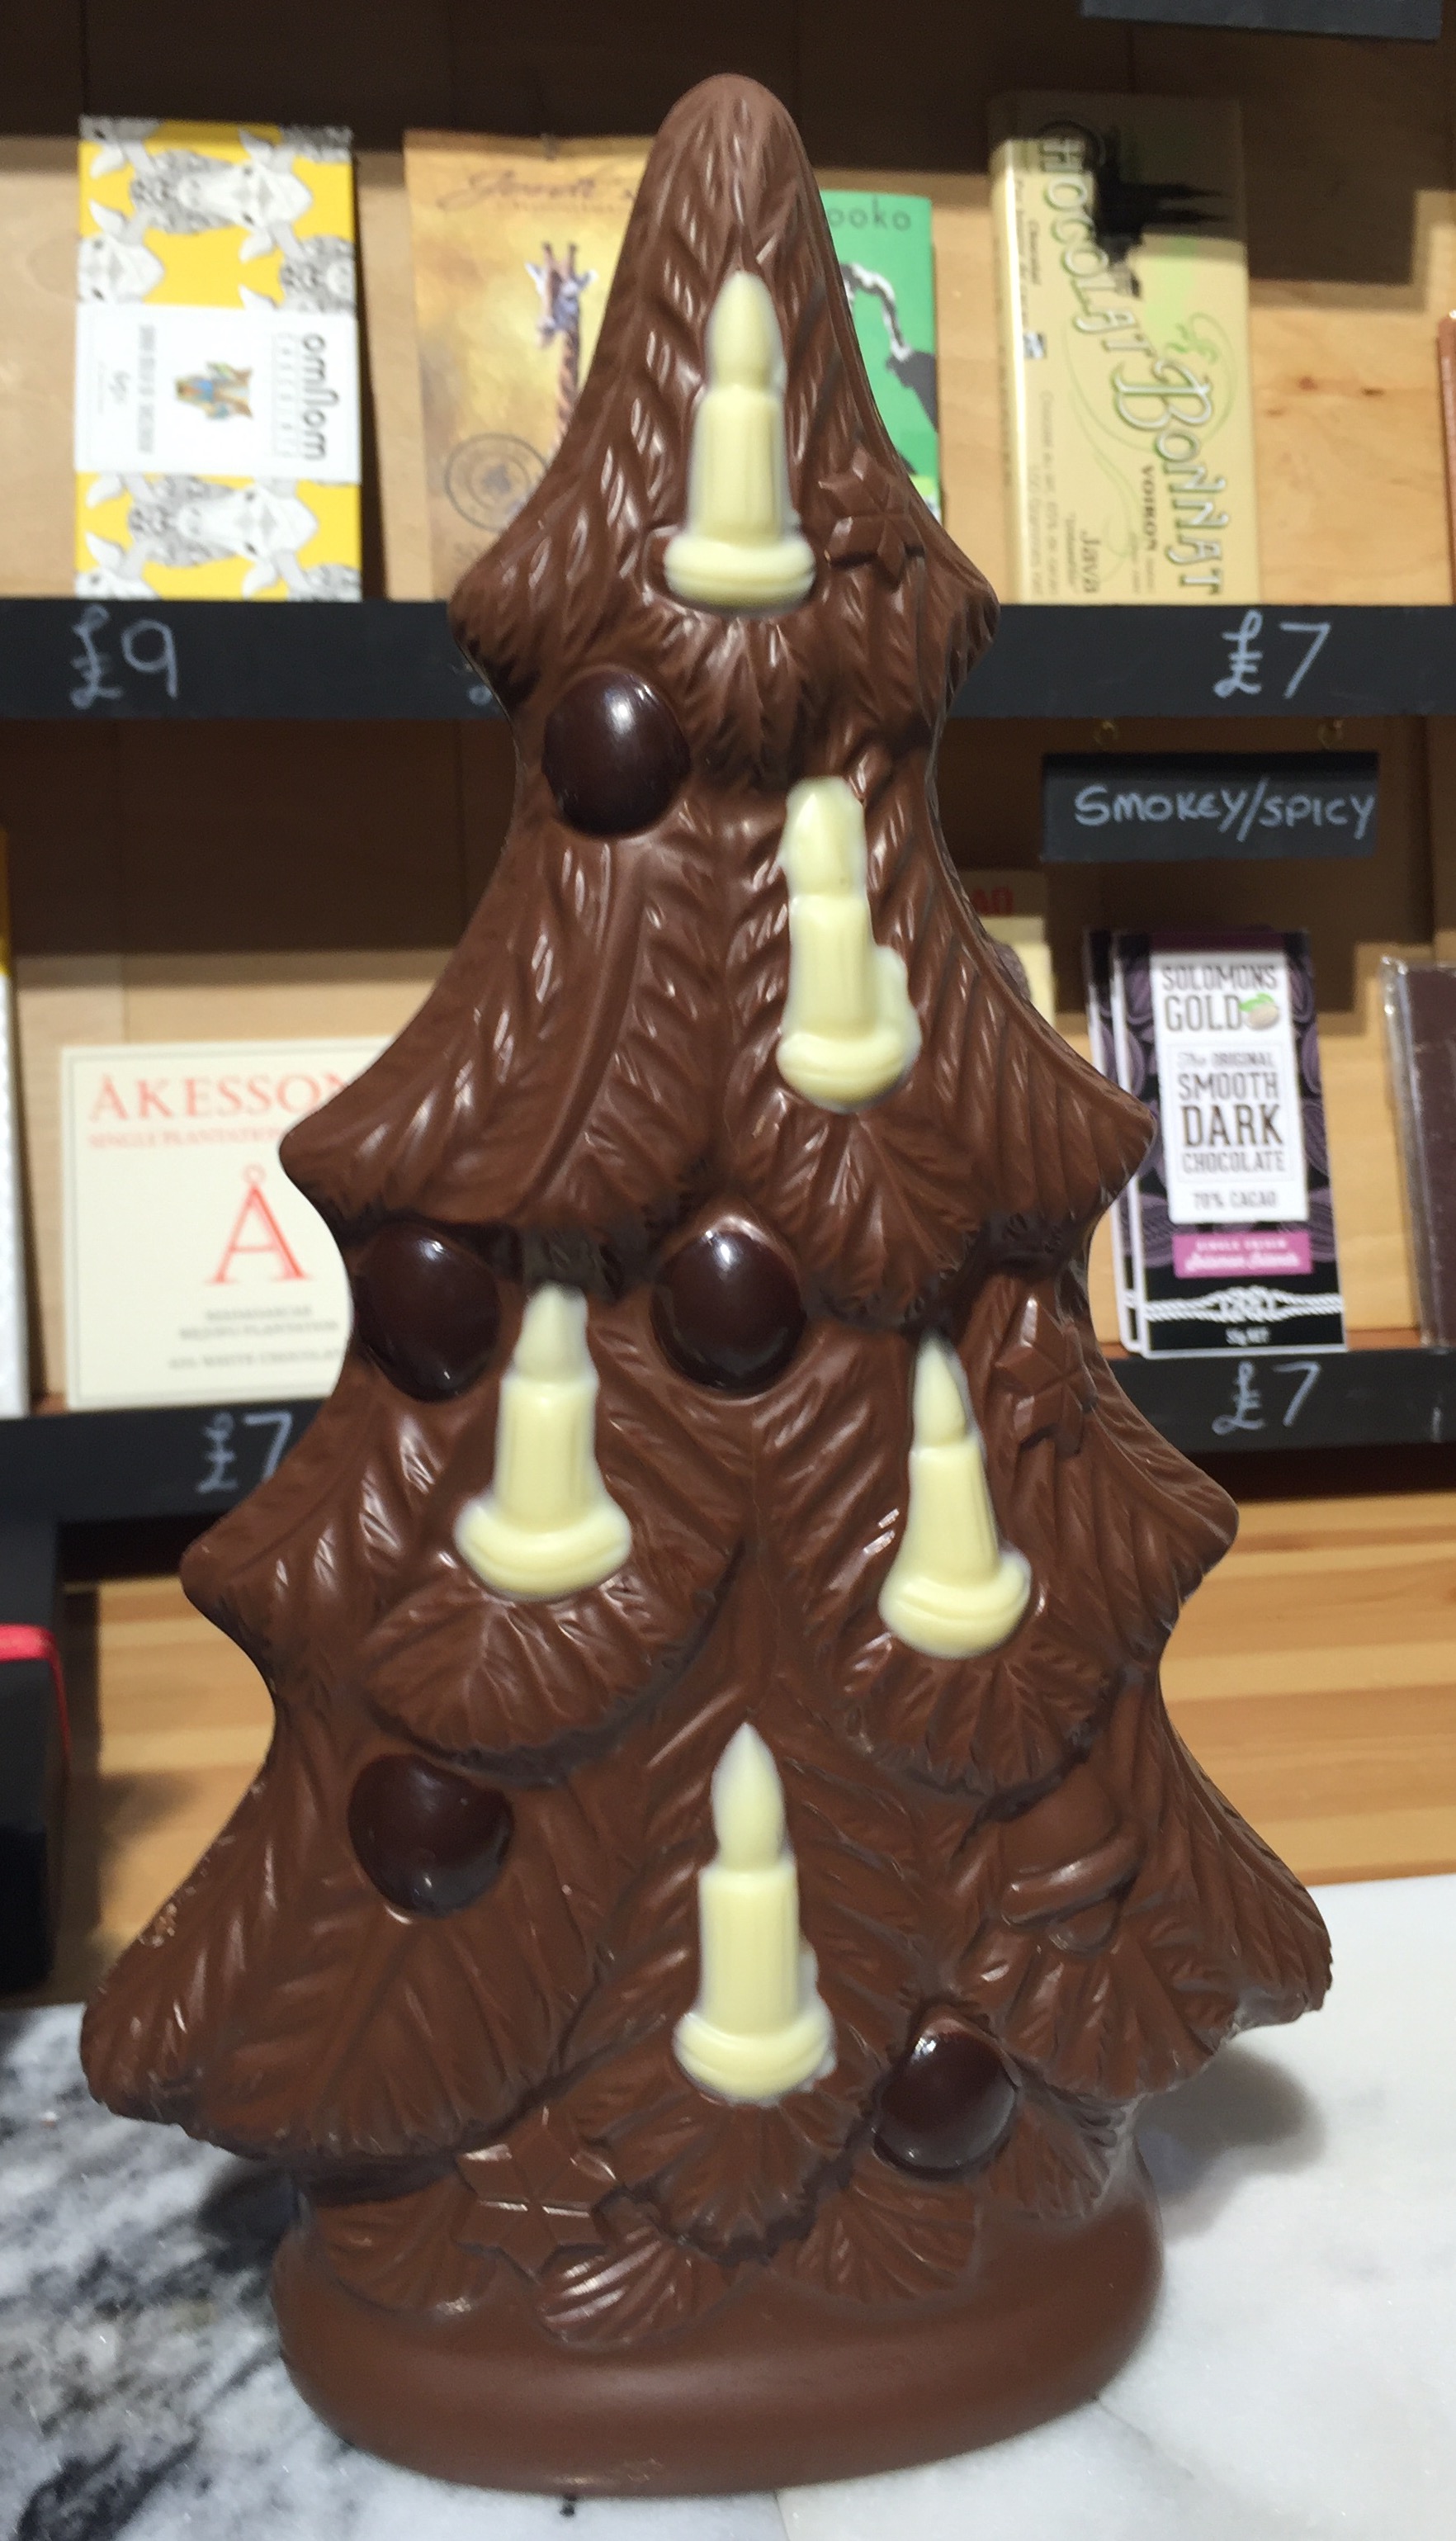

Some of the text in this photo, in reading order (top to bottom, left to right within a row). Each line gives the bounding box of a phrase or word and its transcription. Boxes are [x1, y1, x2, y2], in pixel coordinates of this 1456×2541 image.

[1109, 359, 1229, 595] BONNAT
[1080, 528, 1101, 594] Java
[71, 604, 178, 709] £9
[1213, 609, 1331, 699] £7
[1161, 964, 1278, 991] SOLOMONS
[1165, 995, 1241, 1031] GOLD
[1178, 1072, 1279, 1101] SMOOTH
[1181, 1104, 1284, 1147] DARK
[1182, 1151, 1286, 1174] CHOCOLATE
[1230, 1191, 1277, 1209] CACAO
[1211, 1360, 1321, 1436] £7
[194, 1411, 294, 1493] £7
